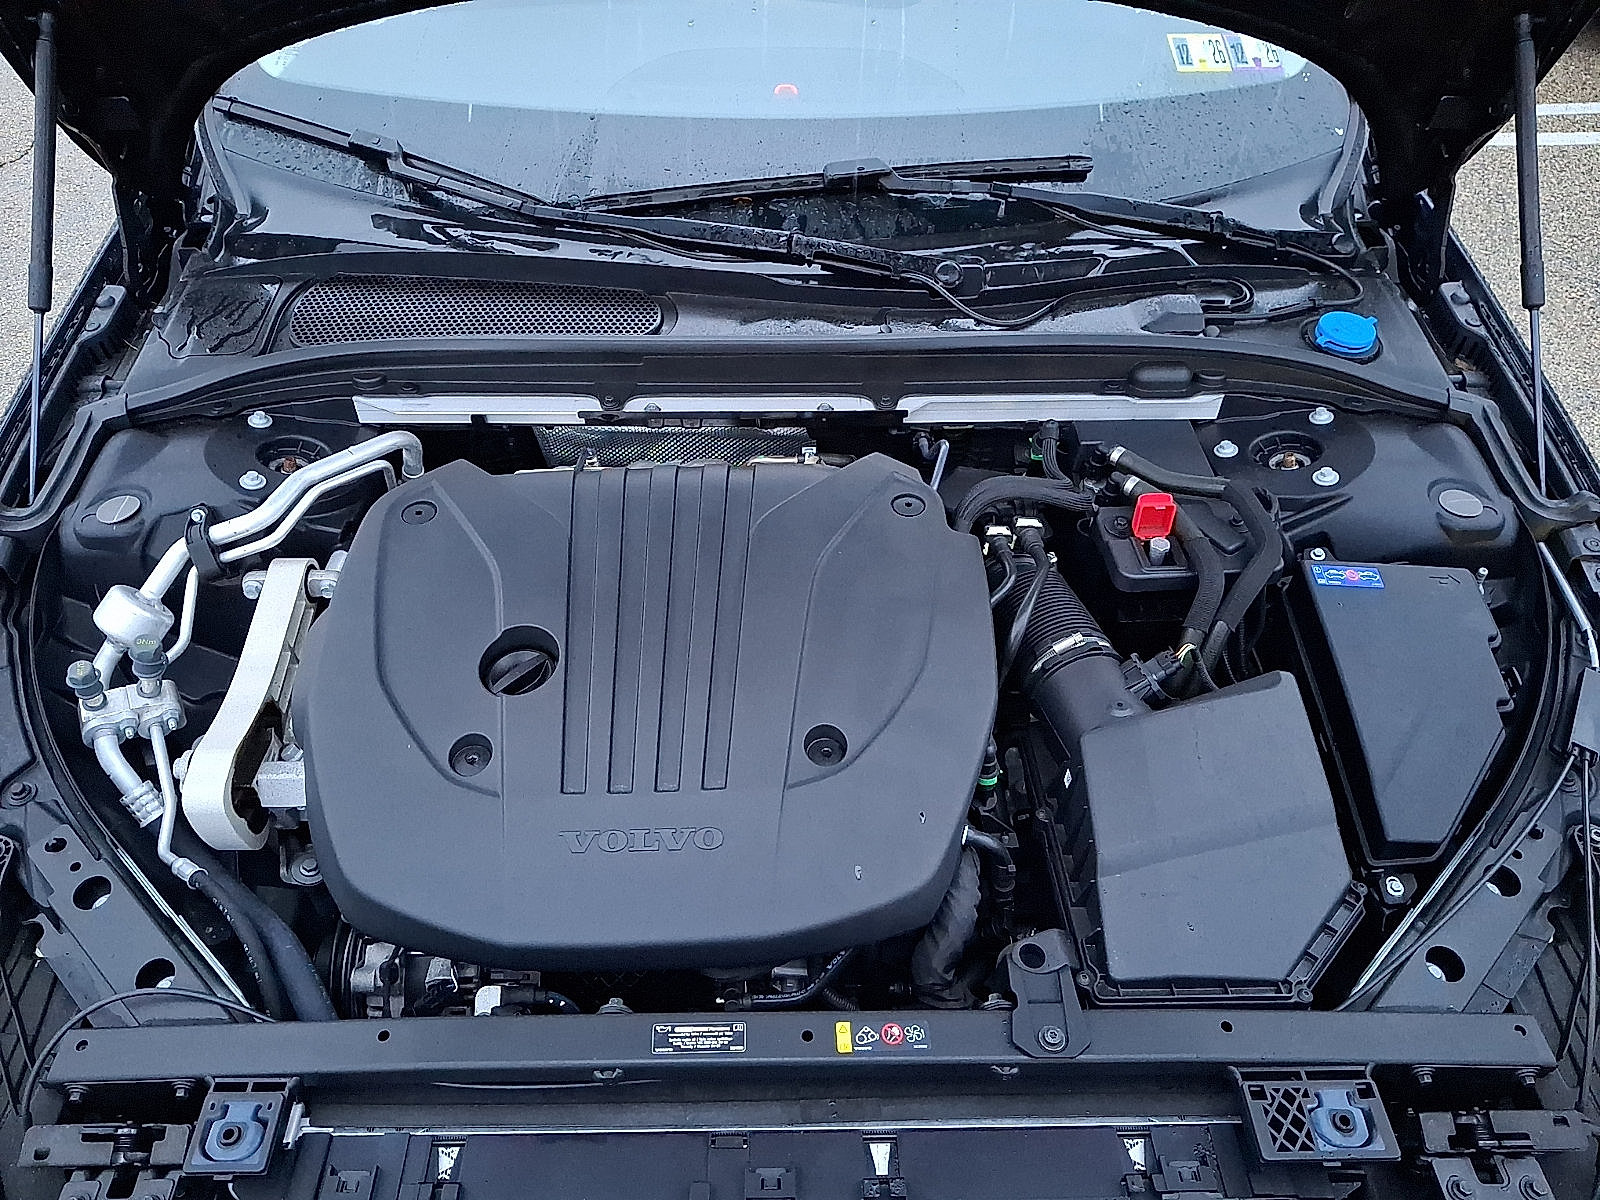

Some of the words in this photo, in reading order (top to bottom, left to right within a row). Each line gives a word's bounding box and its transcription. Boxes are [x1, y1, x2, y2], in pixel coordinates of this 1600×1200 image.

[1175, 43, 1192, 65] 12
[1208, 39, 1226, 64] 26
[1230, 42, 1248, 65] 12
[558, 826, 725, 854] VOLVO
